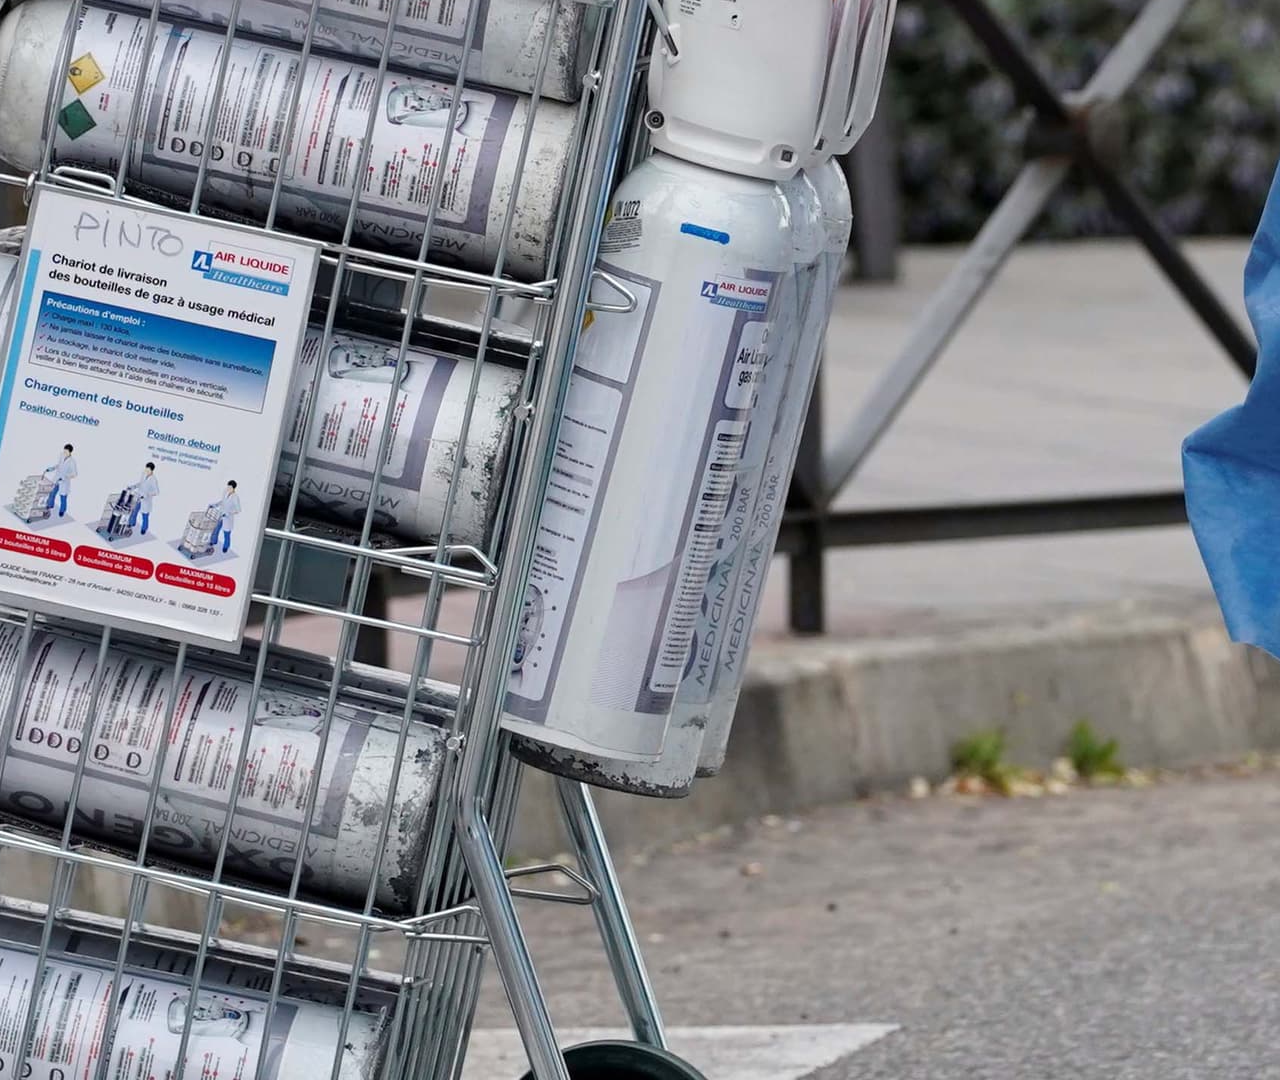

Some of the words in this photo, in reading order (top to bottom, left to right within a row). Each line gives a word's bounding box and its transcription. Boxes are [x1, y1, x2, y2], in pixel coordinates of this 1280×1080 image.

[341, 28, 462, 65] MEDICNAL
[623, 200, 641, 218] 1072
[352, 218, 465, 251] MEDICINA
[51, 252, 96, 272] Chariot
[98, 263, 114, 276] de
[117, 267, 168, 288] livraison
[214, 250, 235, 263] AIR
[239, 255, 289, 275] LIQUIDE
[212, 269, 283, 294] Healthcare
[719, 282, 737, 293] AIR
[48, 268, 71, 282] des
[73, 273, 132, 296] bouteilles
[134, 287, 150, 300] de
[152, 293, 174, 307] gaz
[177, 296, 185, 307] à
[187, 300, 224, 318] usage
[227, 307, 275, 327] médical
[46, 297, 100, 317] Précautions
[100, 309, 140, 327] d'emploi
[98, 346, 123, 357] chariot
[123, 351, 137, 360] doit
[114, 337, 138, 348] chariot
[138, 343, 155, 352] avec
[156, 346, 170, 355] des
[170, 349, 204, 362] bouteilles
[35, 352, 55, 362] veiller
[62, 358, 77, 367] bien
[89, 364, 118, 376] attacher
[124, 372, 143, 382] l'aide
[143, 376, 157, 385] des
[158, 379, 184, 391] chaînes
[185, 385, 195, 393] de
[44, 346, 59, 355] Lors
[70, 352, 111, 368] chargement
[112, 361, 125, 370] des
[126, 364, 159, 377] bouteilles
[170, 373, 197, 386] position
[23, 376, 98, 405] Chargement
[100, 394, 123, 408] des
[125, 398, 185, 422] bouteilles
[18, 400, 57, 417] Position
[59, 409, 100, 427] couchée
[146, 428, 185, 445] Position
[186, 437, 221, 453] debout
[765, 473, 780, 501] BAR
[736, 487, 752, 515] BAR
[730, 516, 745, 541] 200
[758, 503, 773, 529] 200
[3, 537, 34, 551] bouteilles
[35, 545, 44, 553] de
[15, 532, 50, 546] MAXIMUM
[82, 555, 113, 569] bouteilles
[97, 550, 132, 564] MAXIMUM
[38, 570, 63, 582] FRANCE
[164, 572, 195, 585] bouteilles
[195, 579, 204, 587] de
[179, 567, 213, 581] MAXIMUM
